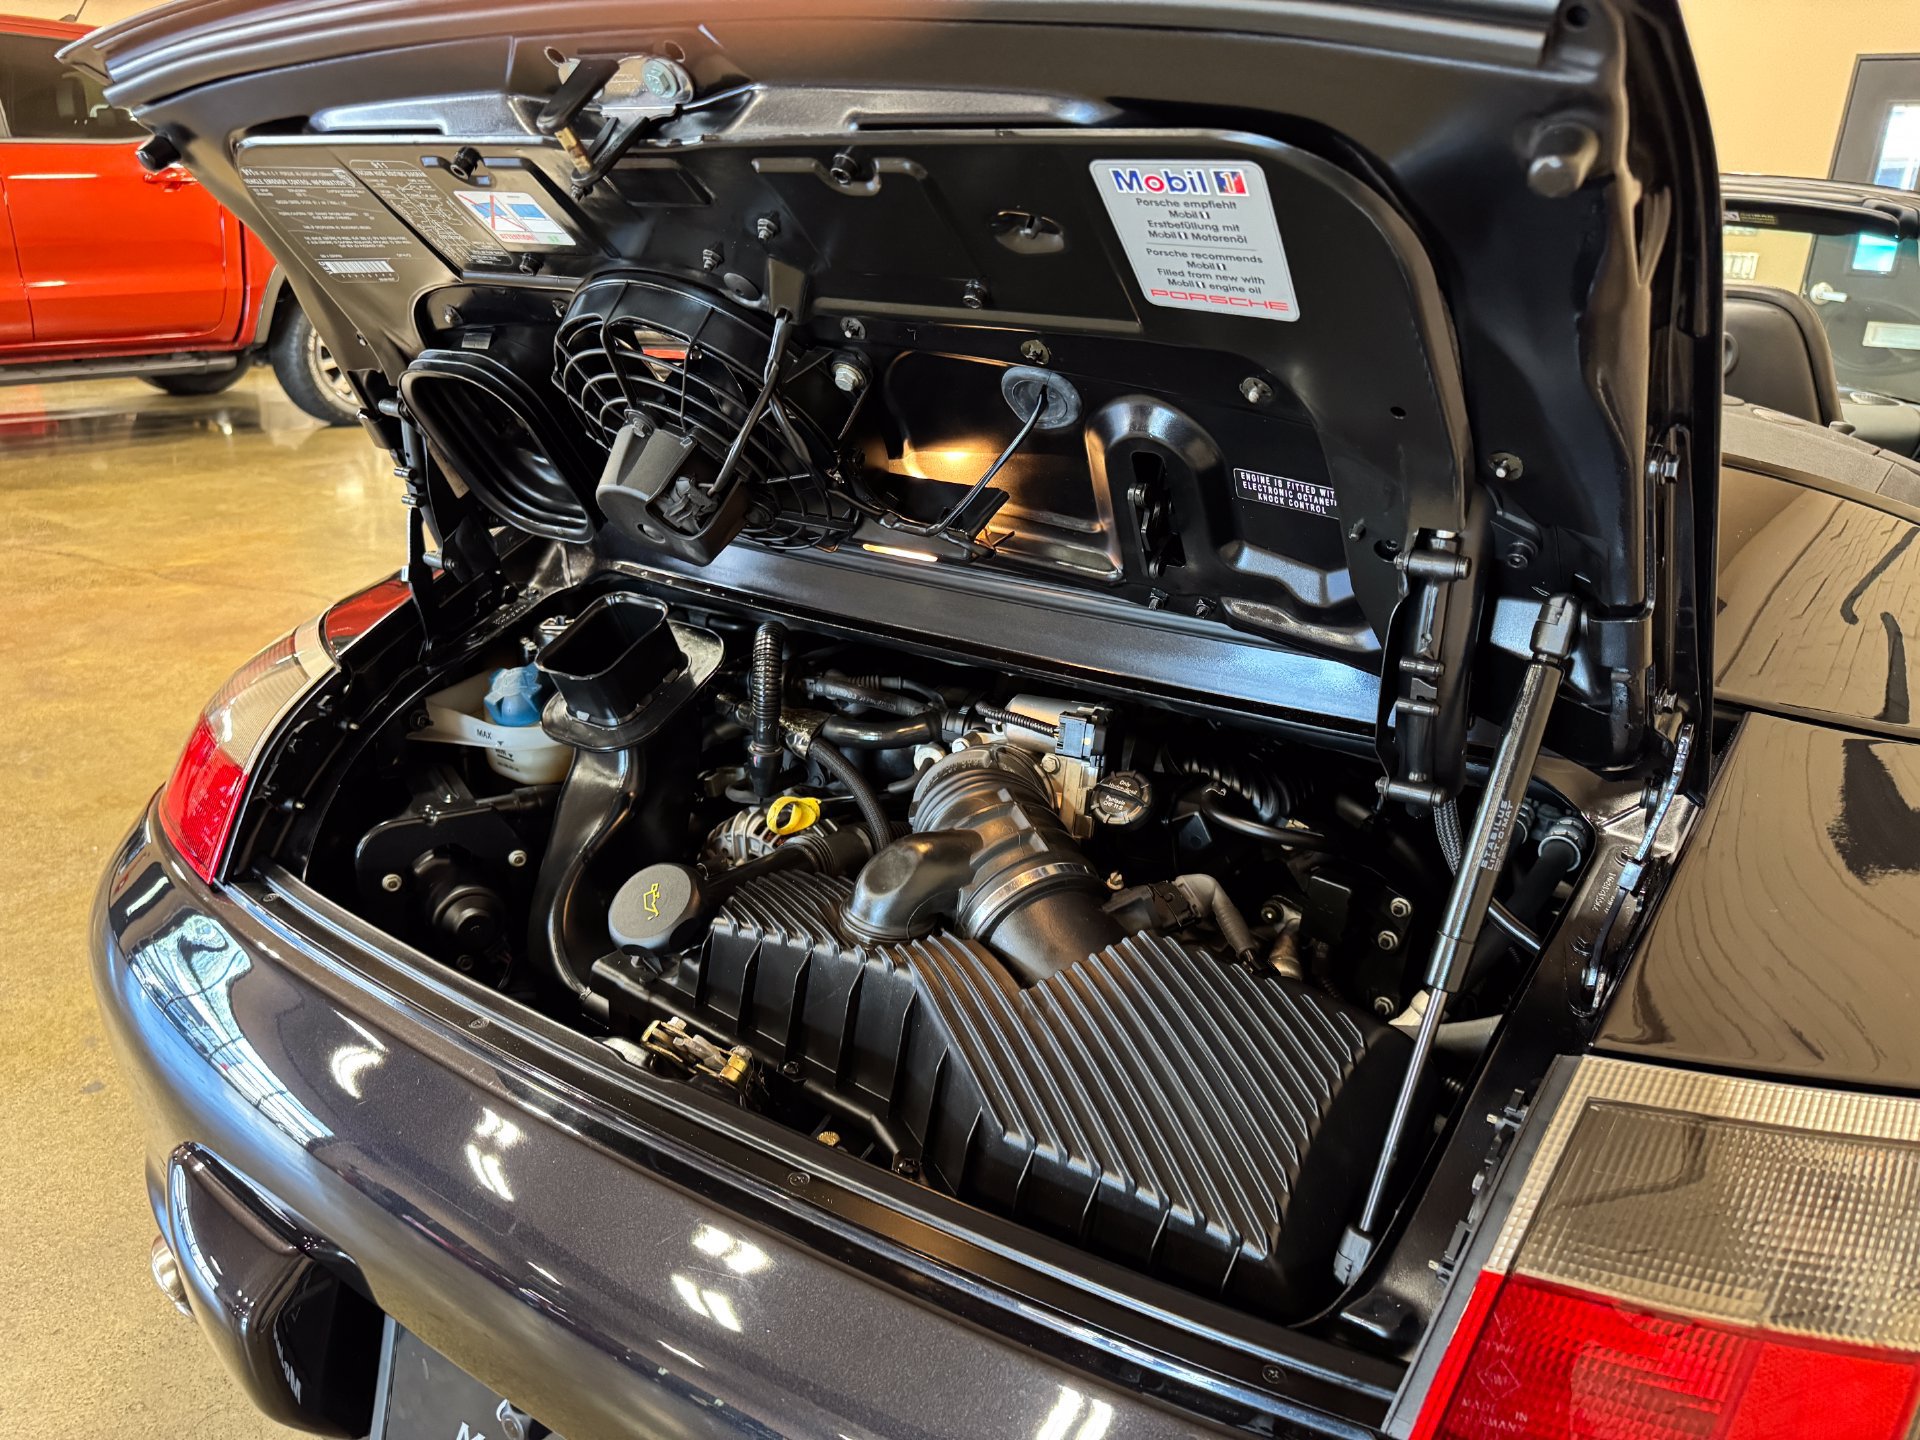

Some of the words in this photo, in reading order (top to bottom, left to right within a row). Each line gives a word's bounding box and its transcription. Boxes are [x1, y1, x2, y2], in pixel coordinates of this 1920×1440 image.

[1110, 169, 1210, 194] Mobil
[1136, 197, 1180, 210] Porsche
[1183, 200, 1238, 212] empfiehlt
[1168, 209, 1198, 220] Mobil
[1147, 219, 1220, 233] Erstbefüllung
[1222, 222, 1240, 233] mit
[1148, 230, 1177, 240] Mobil
[1191, 232, 1248, 244] Motorenöl
[1146, 248, 1188, 259] Porsche
[1190, 251, 1264, 264] recommends
[1186, 260, 1216, 271] Mobil
[1157, 267, 1185, 278] Filled
[1187, 270, 1213, 281] from
[1215, 273, 1239, 283] new
[1241, 274, 1265, 286] with
[1167, 278, 1195, 288] Mobil
[1208, 282, 1246, 295] engine
[1248, 285, 1262, 295] oil
[1150, 288, 1290, 312] PORSCHE
[1240, 471, 1271, 486] ENGINE
[1274, 478, 1283, 488] IS
[1286, 481, 1317, 495] FITTED
[1319, 488, 1336, 500] WIT
[1242, 480, 1294, 499] ELECTRONIC
[1257, 492, 1285, 506] KNOCK
[1288, 500, 1327, 515] CONTROL
[476, 728, 492, 740] MAX
[1481, 800, 1508, 869] STABILUS
